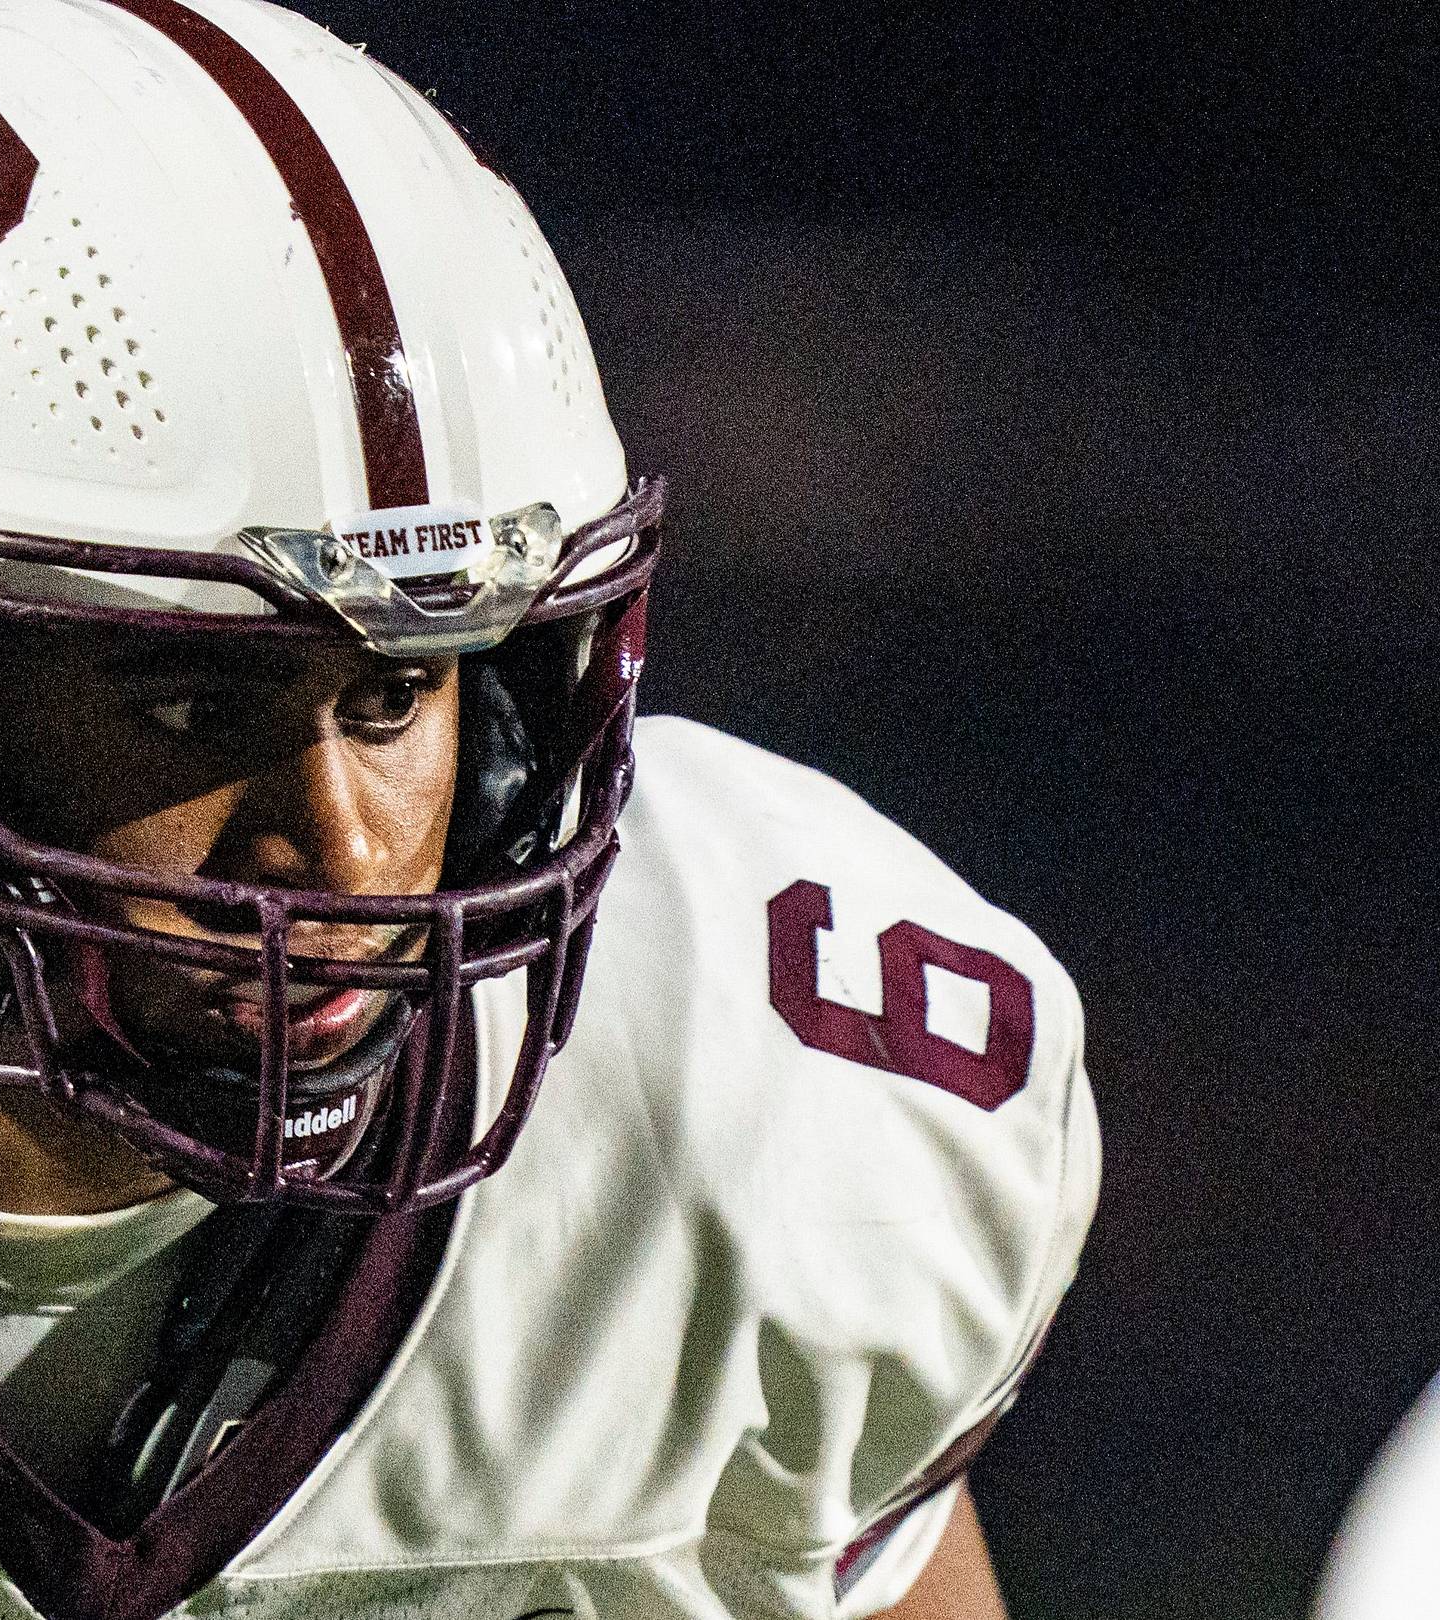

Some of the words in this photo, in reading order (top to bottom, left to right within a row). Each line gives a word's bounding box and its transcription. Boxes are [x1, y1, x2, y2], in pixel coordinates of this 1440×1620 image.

[341, 527, 409, 558] TEAM
[414, 519, 482, 553] FIRST
[767, 879, 1036, 1113] 6
[284, 1094, 357, 1139] iddell
